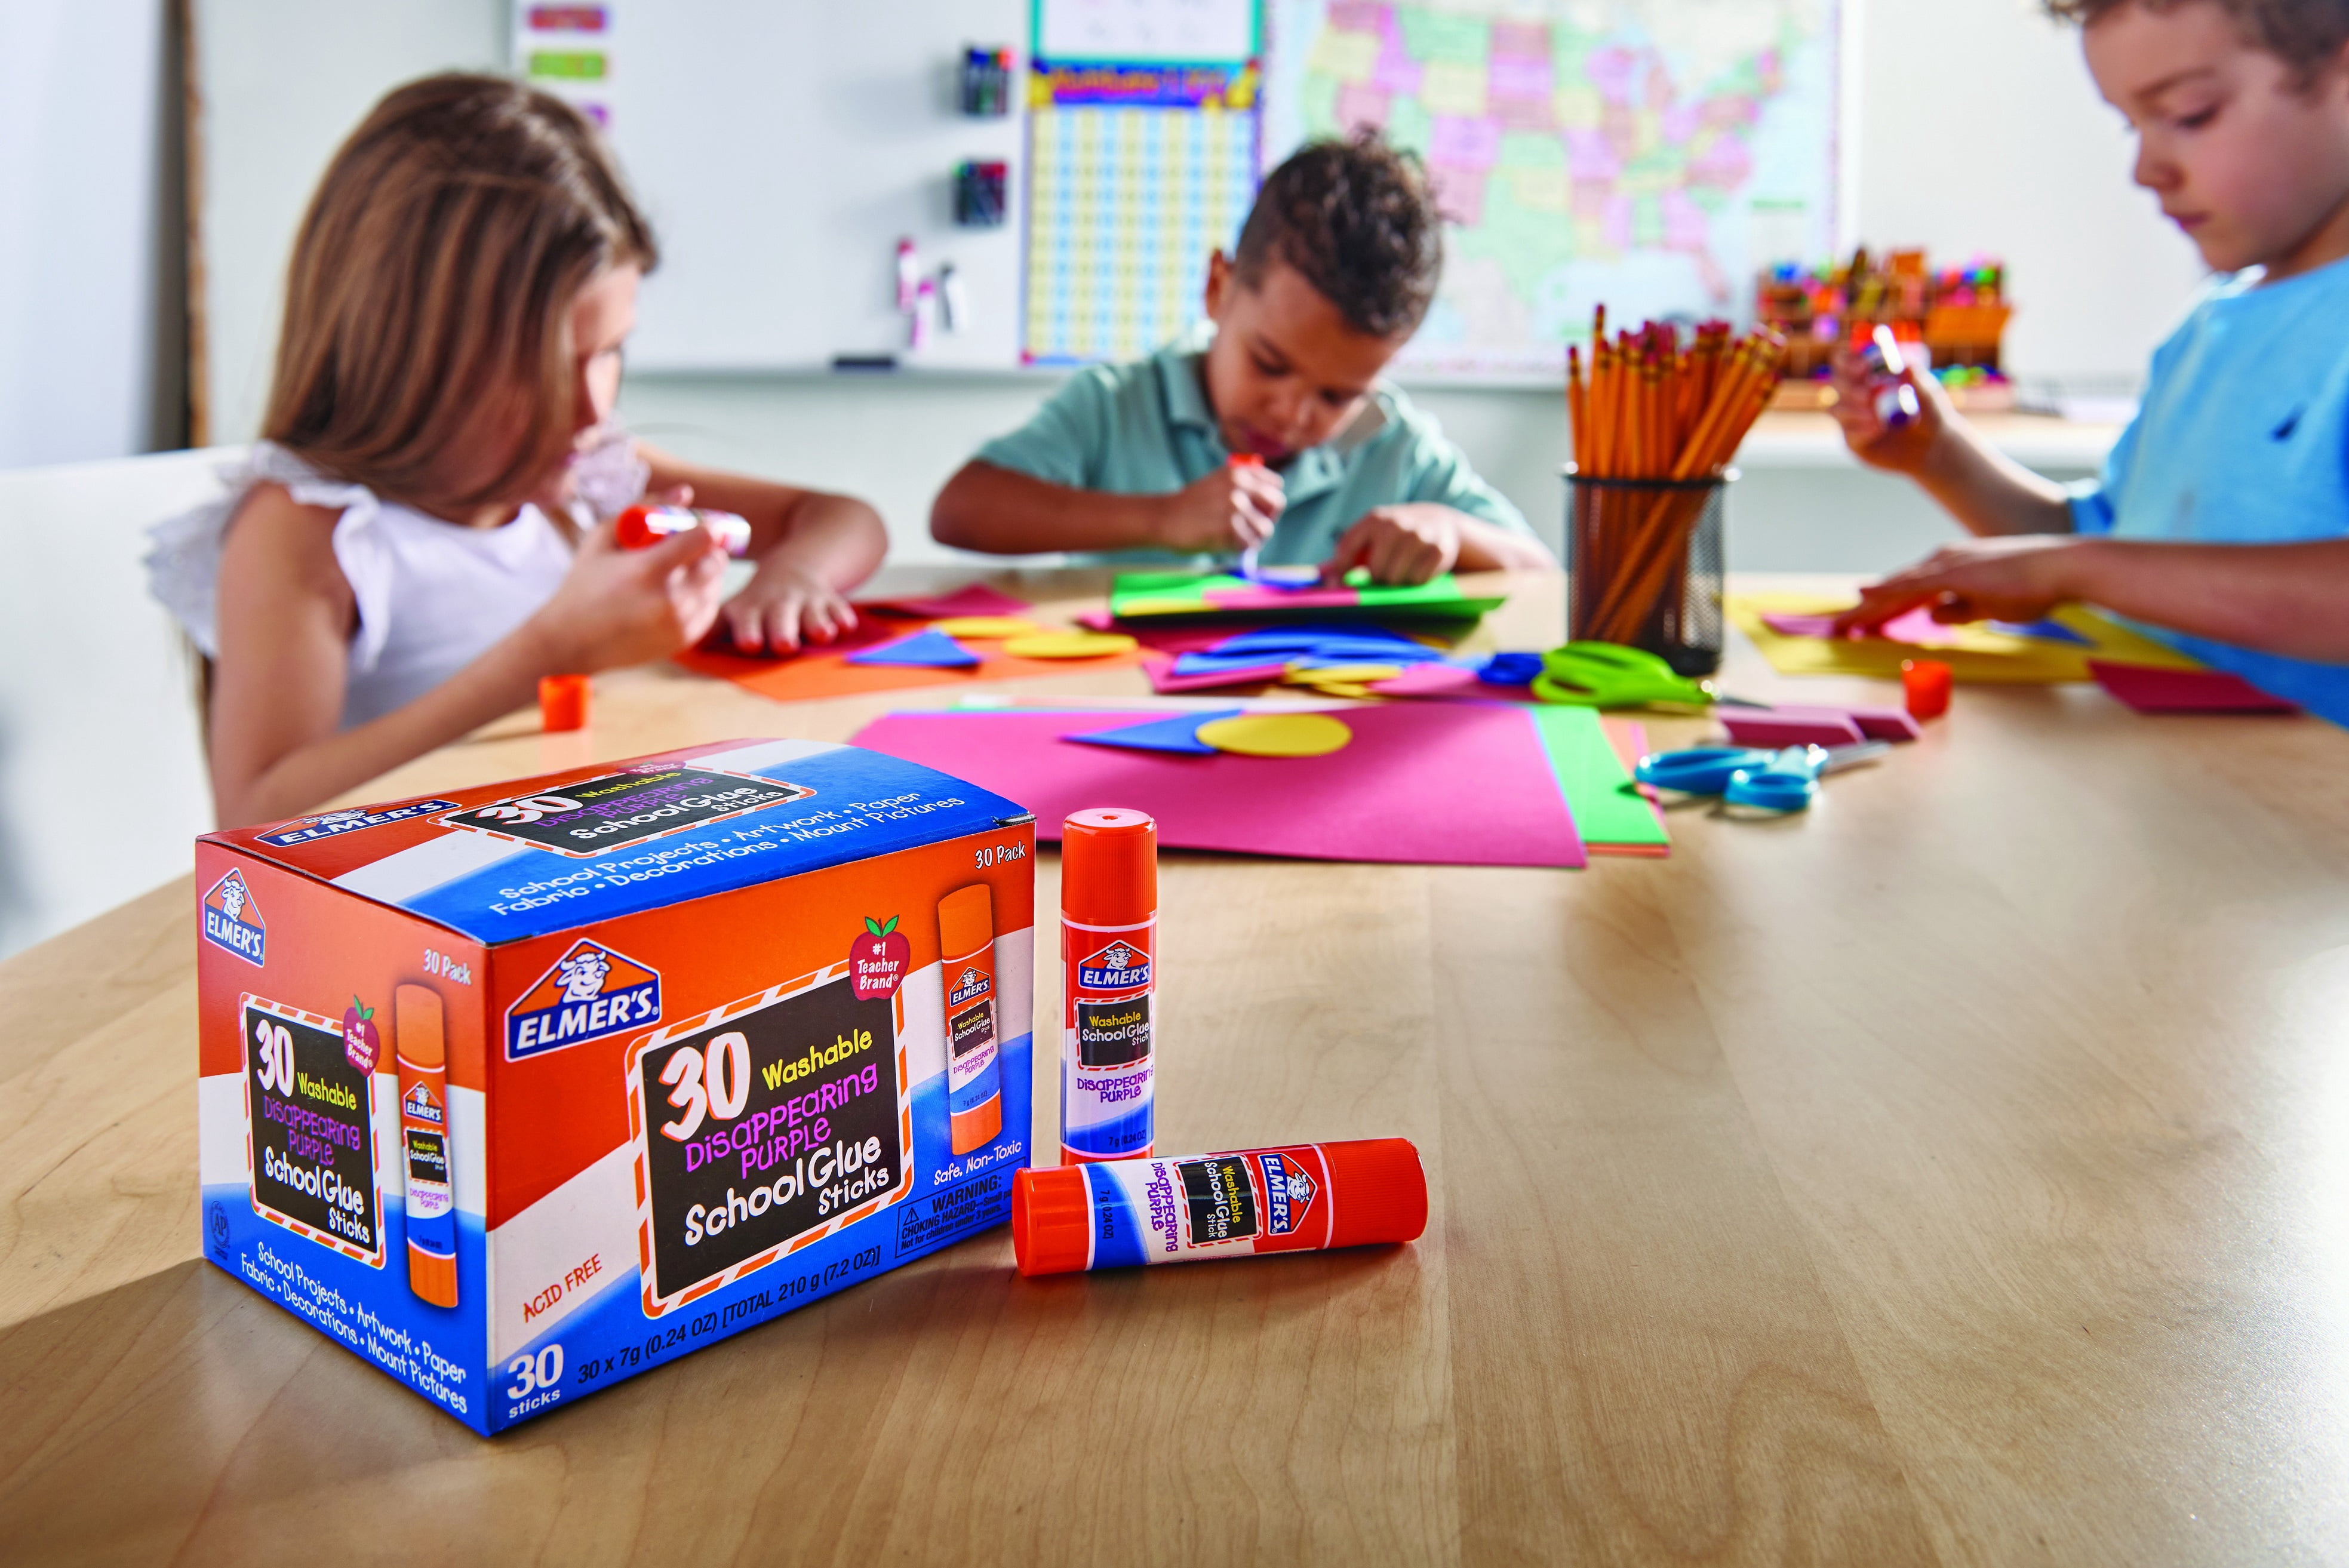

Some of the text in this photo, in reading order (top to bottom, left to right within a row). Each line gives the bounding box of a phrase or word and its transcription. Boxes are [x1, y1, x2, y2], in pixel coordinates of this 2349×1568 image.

[475, 771, 682, 825] 30 Washable
[711, 790, 784, 812] Sticks
[278, 802, 442, 843] ELMER'S
[489, 797, 965, 916] Fabric Decorations Mount Pictures
[499, 792, 920, 899] School Projects Artwork Paper
[975, 841, 1026, 869] 30 Pack
[207, 911, 262, 957] ELMER'S
[872, 941, 886, 957] #1
[423, 948, 472, 986] 30 Pack
[857, 957, 899, 974] Teacher
[1083, 965, 1149, 985] ELMER'S
[952, 979, 988, 1003] ELMER'S
[516, 986, 654, 1050] ELMER'S
[957, 1011, 984, 1031] Washable
[980, 1025, 990, 1033] Stick
[1089, 1011, 1141, 1027] Washable
[346, 1028, 373, 1057] Teacher
[1132, 1032, 1149, 1046] Stick
[256, 1019, 357, 1110] 30 Washable
[658, 1028, 873, 1142] 30 Washable
[407, 1102, 441, 1121] ELMER'S
[412, 1140, 438, 1152] Washable
[1108, 1136, 1113, 1146] 7
[1114, 1138, 1120, 1148] g
[933, 1140, 1022, 1186] Safe, Non-Toxic
[818, 1166, 890, 1216] Sticks
[931, 1174, 1002, 1214] WARNING:
[1222, 1165, 1243, 1223] Washable
[1264, 1157, 1289, 1232] ELMER'S
[328, 1207, 370, 1244] Sticks
[900, 1238, 914, 1250] Not
[915, 1234, 925, 1245] for
[926, 1222, 954, 1240] children
[955, 1212, 975, 1230] under
[976, 1209, 981, 1220] 3
[901, 1215, 940, 1240] CHOKING
[1100, 1203, 1114, 1223] (0.24
[1207, 1213, 1219, 1238] Stick
[1102, 1224, 1114, 1240] OZ)
[522, 1253, 602, 1323] ACID FREE
[258, 1241, 466, 1384] School Projects Artwork Paper
[577, 1244, 881, 1384] 30 x 7g (0.24 OZ) [TOTAL 210 g (7.2 OZ)]
[241, 1252, 468, 1414] Fabric Decorations Mount Pictures
[507, 1343, 564, 1400] 30
[509, 1389, 561, 1419] sticks
